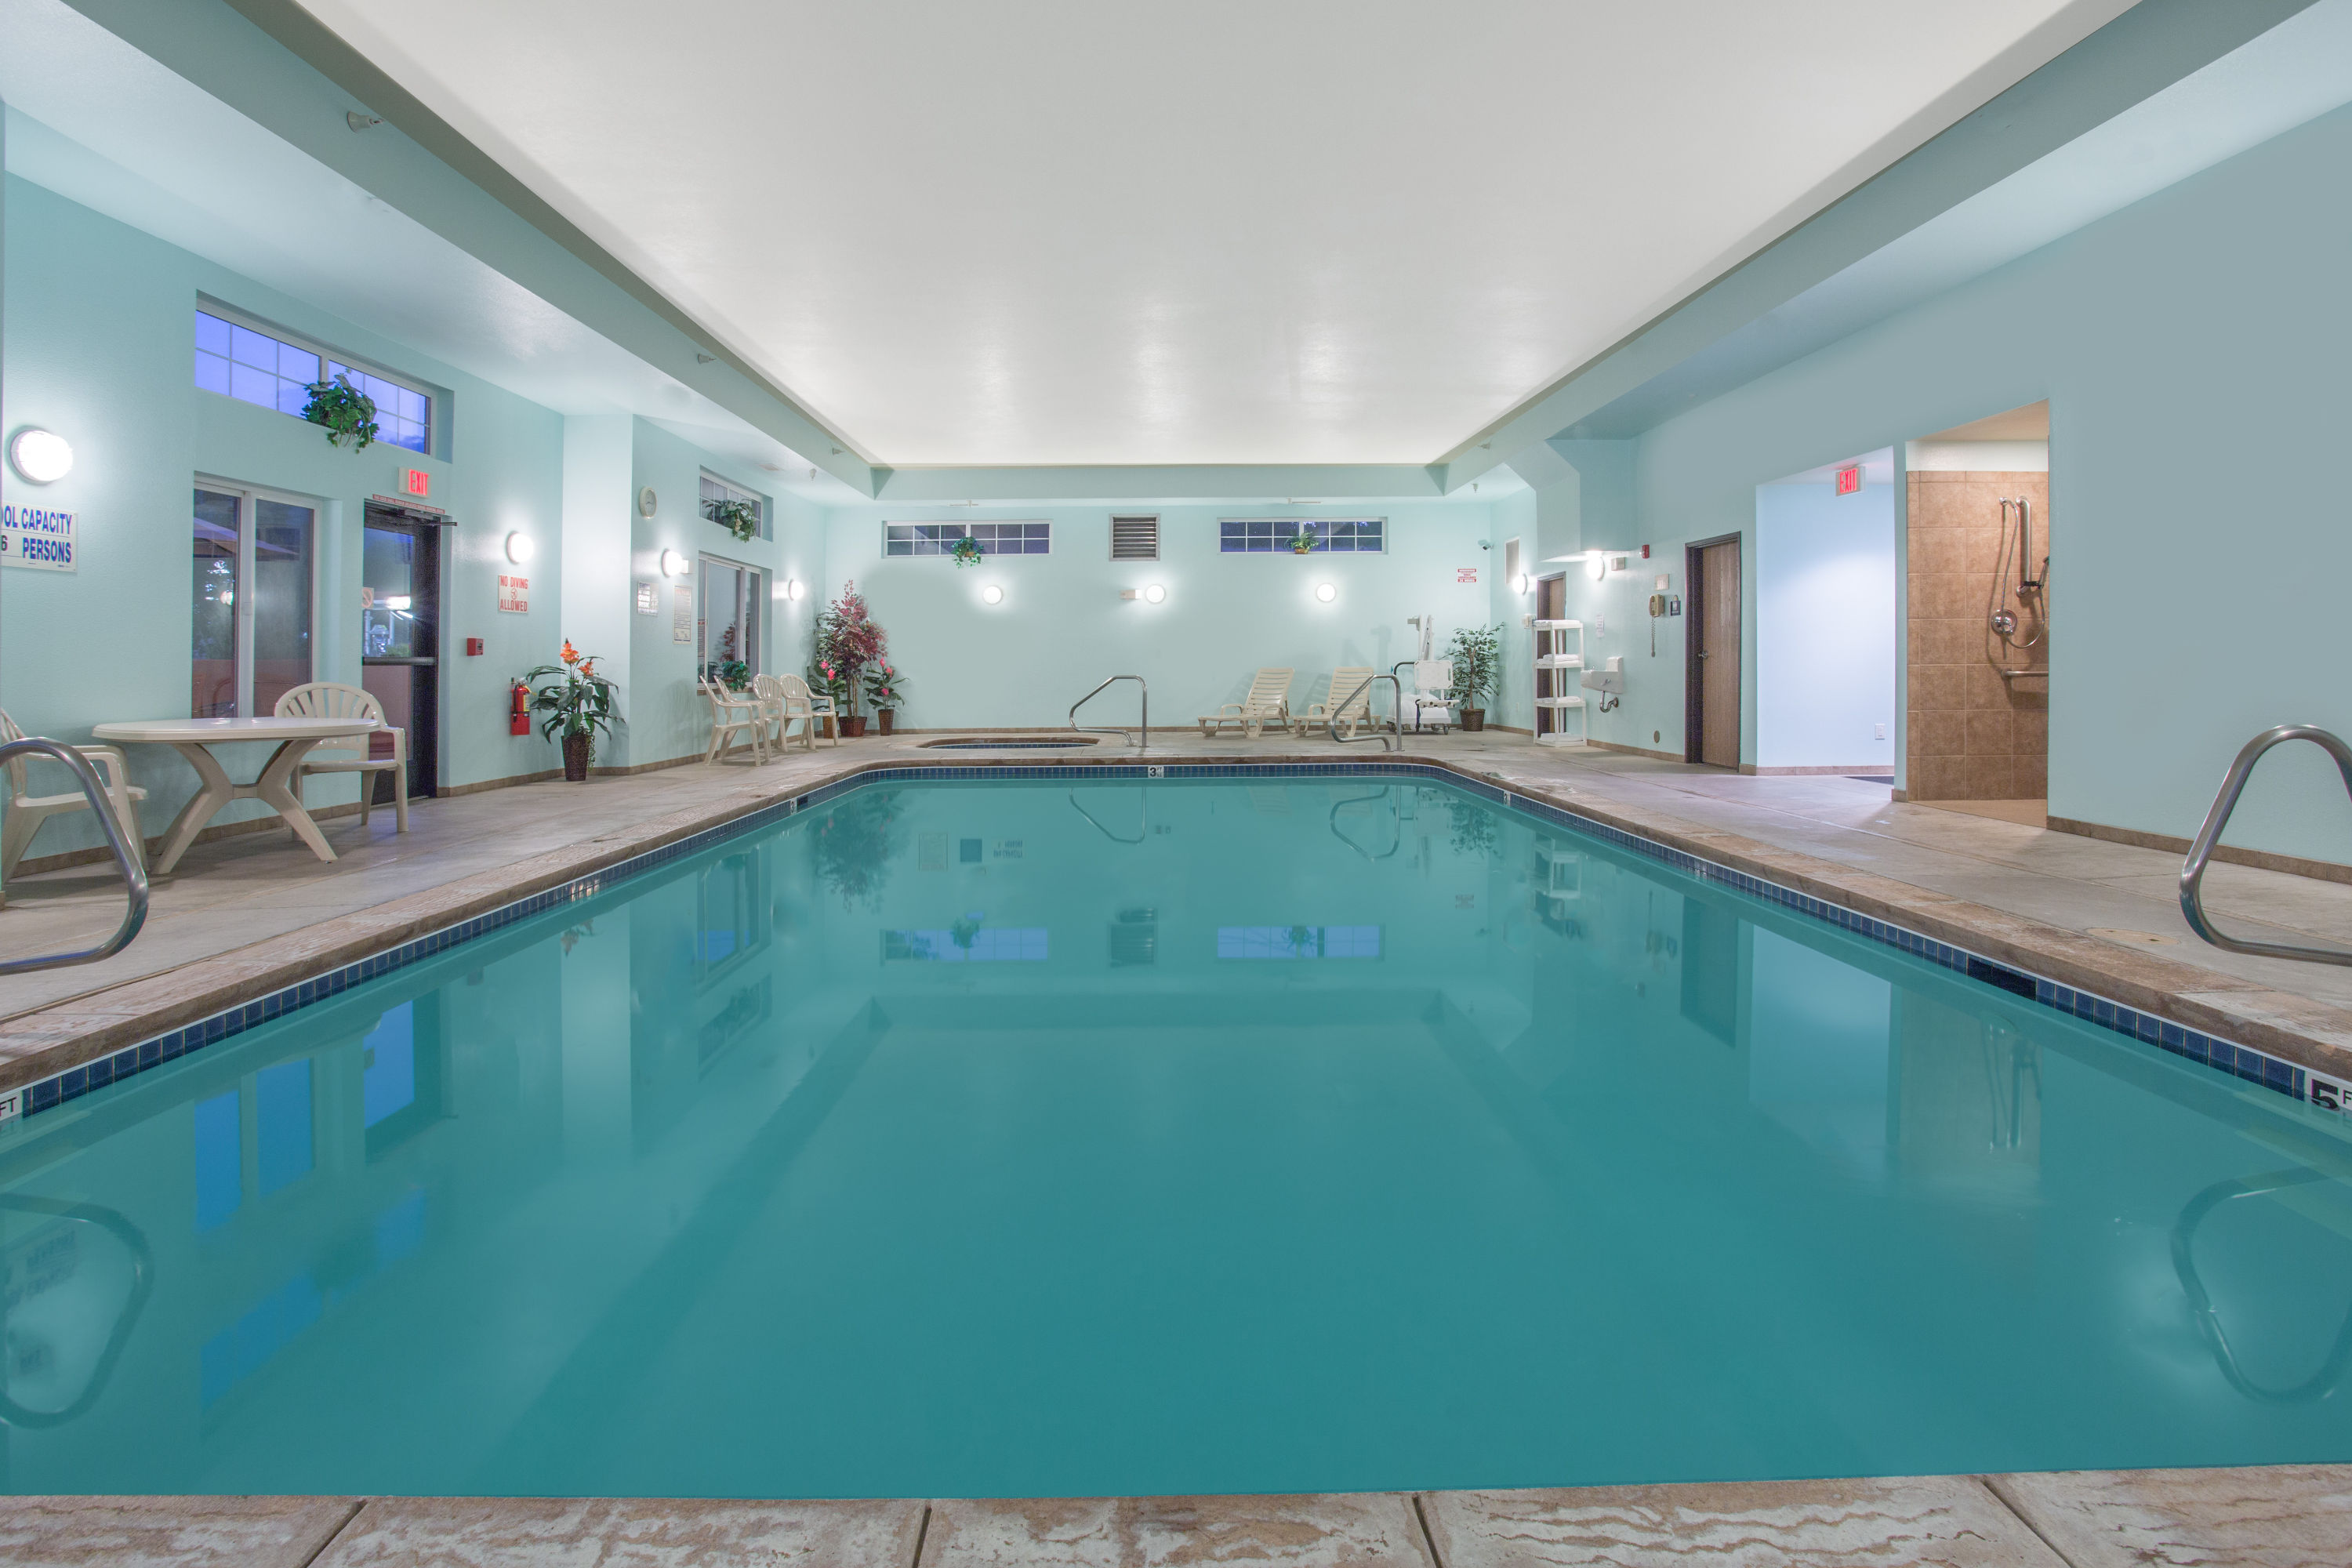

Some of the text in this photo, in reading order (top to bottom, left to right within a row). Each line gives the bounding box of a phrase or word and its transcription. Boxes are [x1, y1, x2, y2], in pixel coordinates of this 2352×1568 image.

[408, 469, 429, 495] EXIT
[1839, 468, 1858, 494] EXIT
[21, 508, 72, 534] CAPACITY
[22, 536, 72, 563] PERSONS
[500, 575, 528, 589] NO DIVING
[499, 599, 527, 612] ALLOWED
[1149, 767, 1156, 777] 3
[2311, 1078, 2339, 1112] 5
